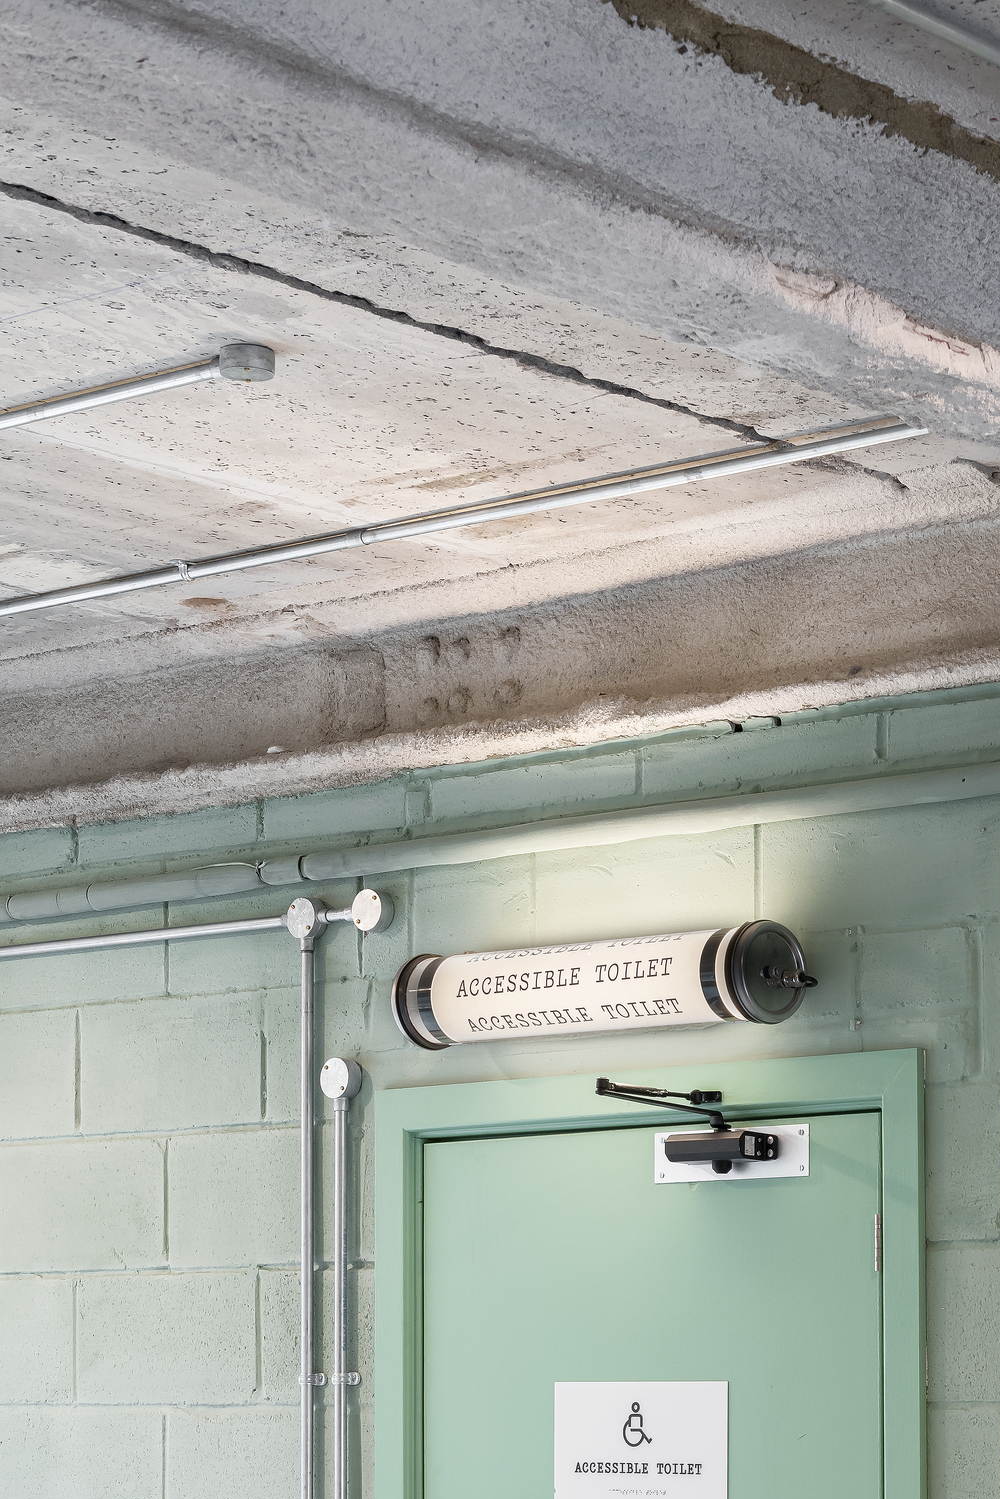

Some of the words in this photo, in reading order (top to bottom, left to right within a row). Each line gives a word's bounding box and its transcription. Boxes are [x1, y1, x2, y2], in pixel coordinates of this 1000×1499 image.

[456, 967, 581, 998] ACCESSIBLE
[595, 957, 674, 983] TOILET
[467, 1007, 594, 1033] ACCESSIBLE
[601, 998, 684, 1019] TOILET
[574, 1462, 649, 1475] ACCESSIBLE
[656, 1463, 703, 1475] TOILET
